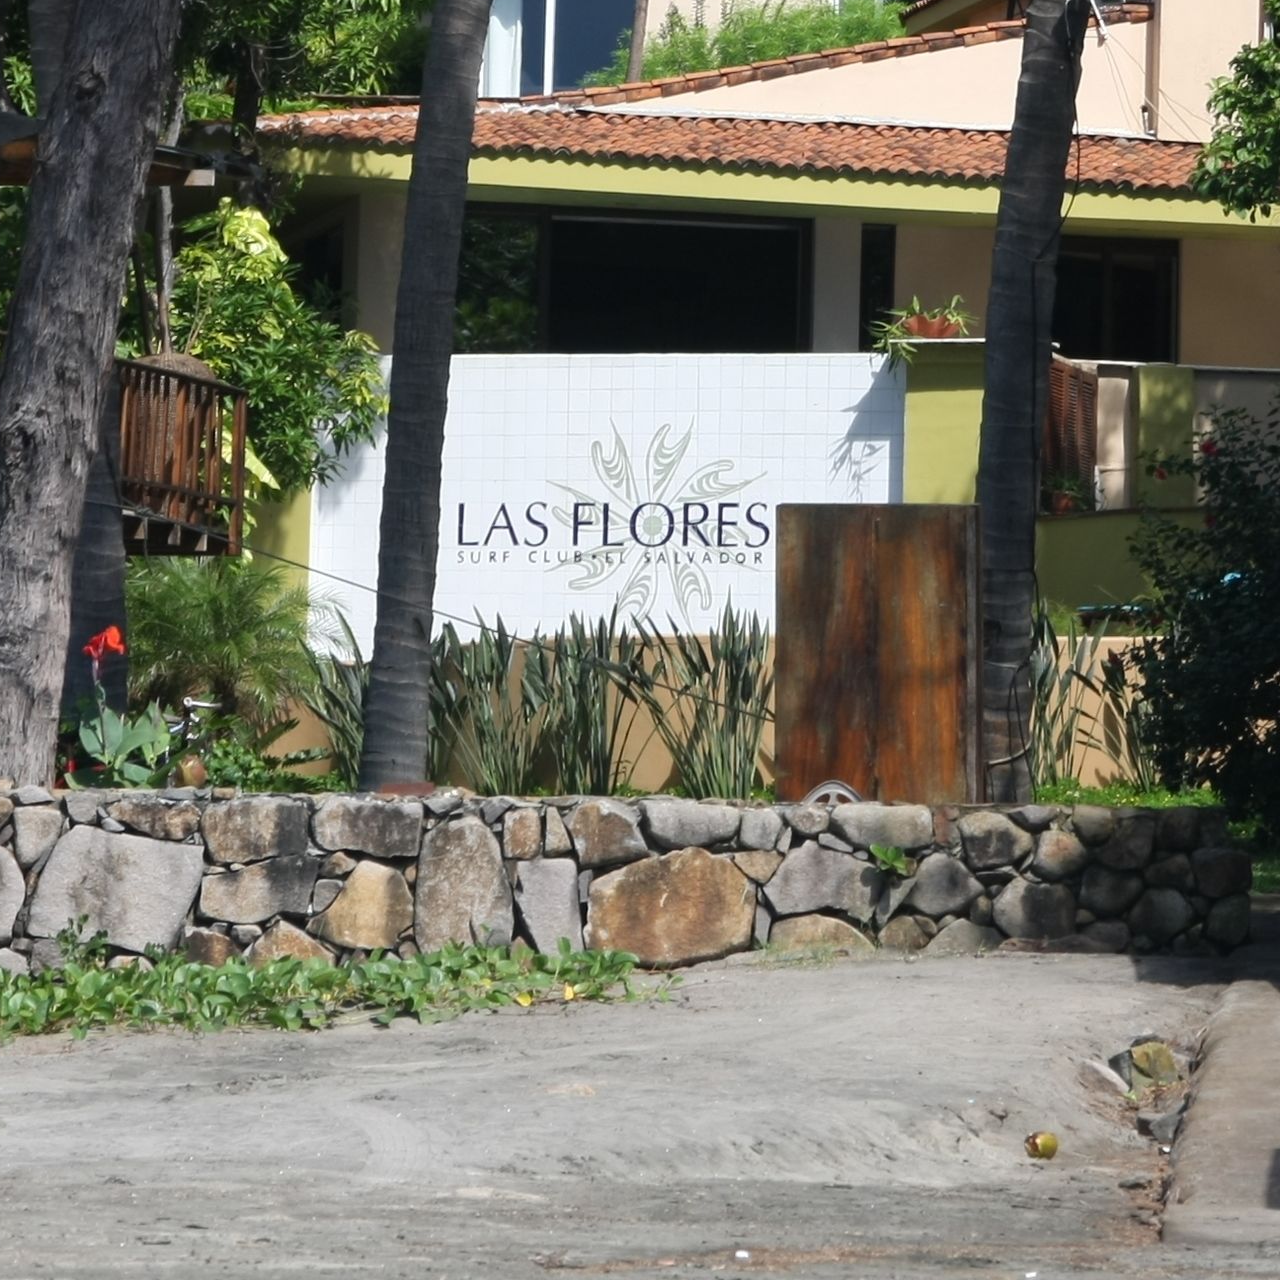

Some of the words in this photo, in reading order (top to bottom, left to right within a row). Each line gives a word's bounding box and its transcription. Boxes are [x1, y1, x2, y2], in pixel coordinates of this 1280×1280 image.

[457, 501, 549, 547] LAS
[572, 501, 770, 548] FLORES
[457, 551, 511, 564] SURF
[643, 551, 763, 564] SALVADOR
